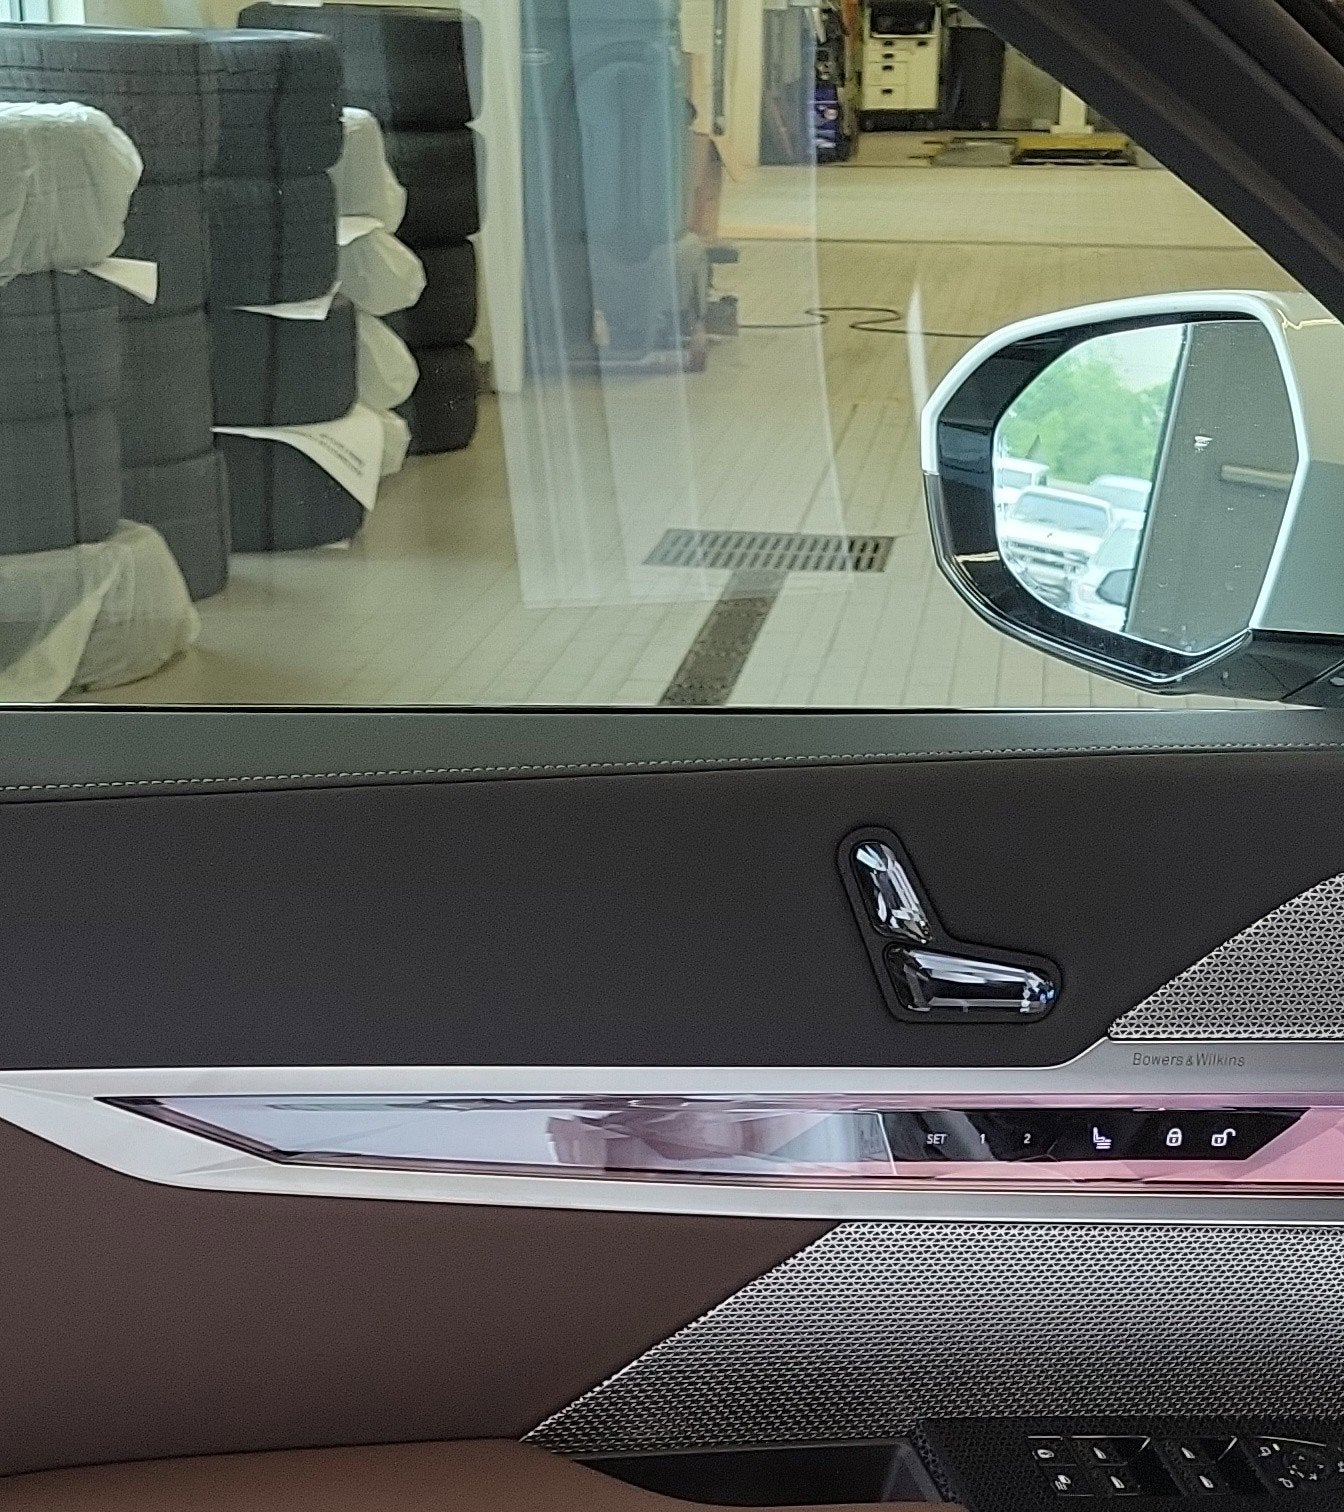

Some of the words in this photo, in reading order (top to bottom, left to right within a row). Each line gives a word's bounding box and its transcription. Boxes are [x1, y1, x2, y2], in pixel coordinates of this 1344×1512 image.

[1133, 1052, 1184, 1066] Bowers
[1196, 1052, 1246, 1067] Wilkins
[926, 1133, 948, 1145] SET
[980, 1133, 986, 1145] 1
[1023, 1132, 1032, 1144] 2
